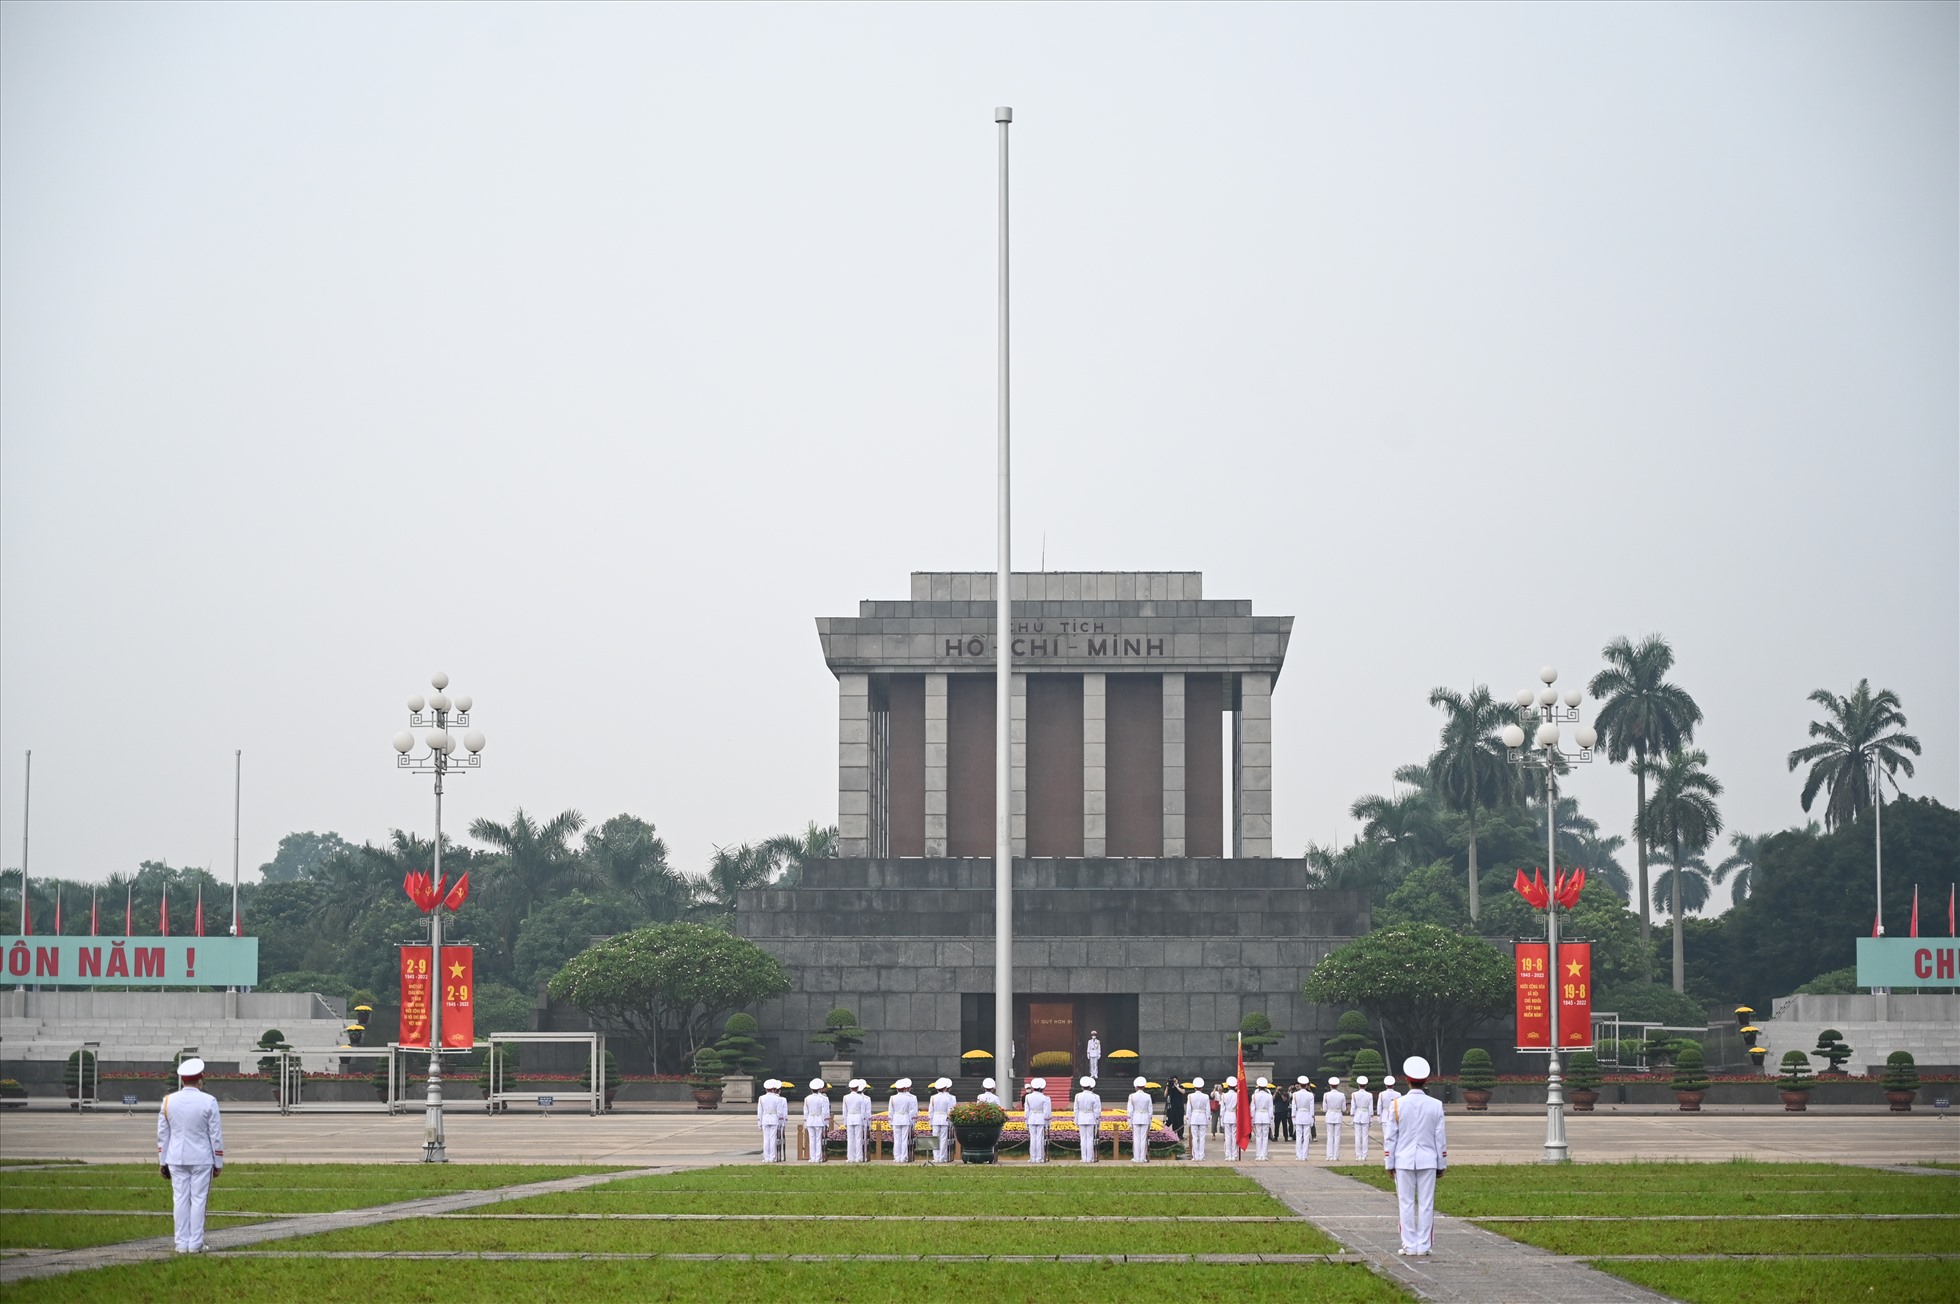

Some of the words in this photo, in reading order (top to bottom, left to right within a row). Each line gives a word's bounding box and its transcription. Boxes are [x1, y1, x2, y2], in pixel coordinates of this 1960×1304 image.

[1010, 618, 1044, 632] HỦ
[945, 634, 986, 656] HỒ
[1087, 632, 1164, 656] MINH
[0, 940, 59, 976] ÔN
[78, 940, 166, 978] NĂM
[1521, 958, 1542, 972] 19-8
[1914, 948, 1960, 979] CH
[447, 985, 468, 1000] 2-9
[1564, 984, 1586, 998] 19-8
